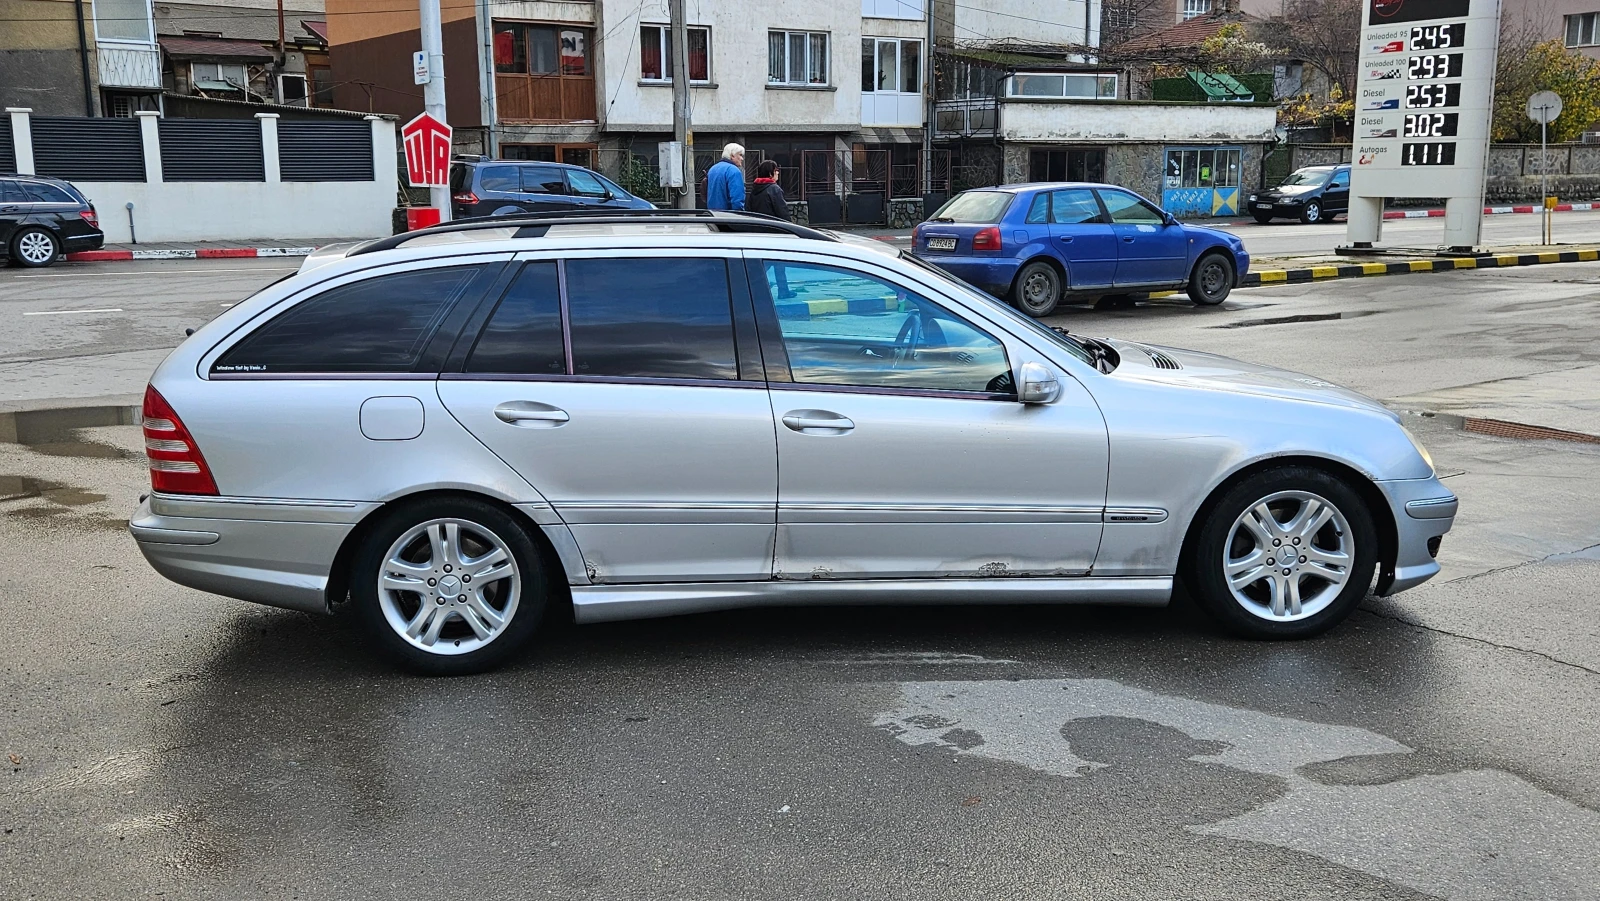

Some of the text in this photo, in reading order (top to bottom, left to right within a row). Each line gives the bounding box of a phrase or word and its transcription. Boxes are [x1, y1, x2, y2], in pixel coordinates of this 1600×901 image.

[1367, 30, 1408, 40] Unleaded 95
[1410, 24, 1451, 50] 2.45
[1365, 59, 1394, 68] Unleaded
[1408, 54, 1449, 79] 2.93
[1363, 89, 1386, 97] Diesel
[1406, 84, 1447, 108] 2.53
[1361, 117, 1384, 125] Diesel
[1404, 113, 1445, 137] 3.02
[403, 114, 451, 185] UTA
[1359, 146, 1388, 154] Autogas
[1408, 144, 1443, 166] 1.11
